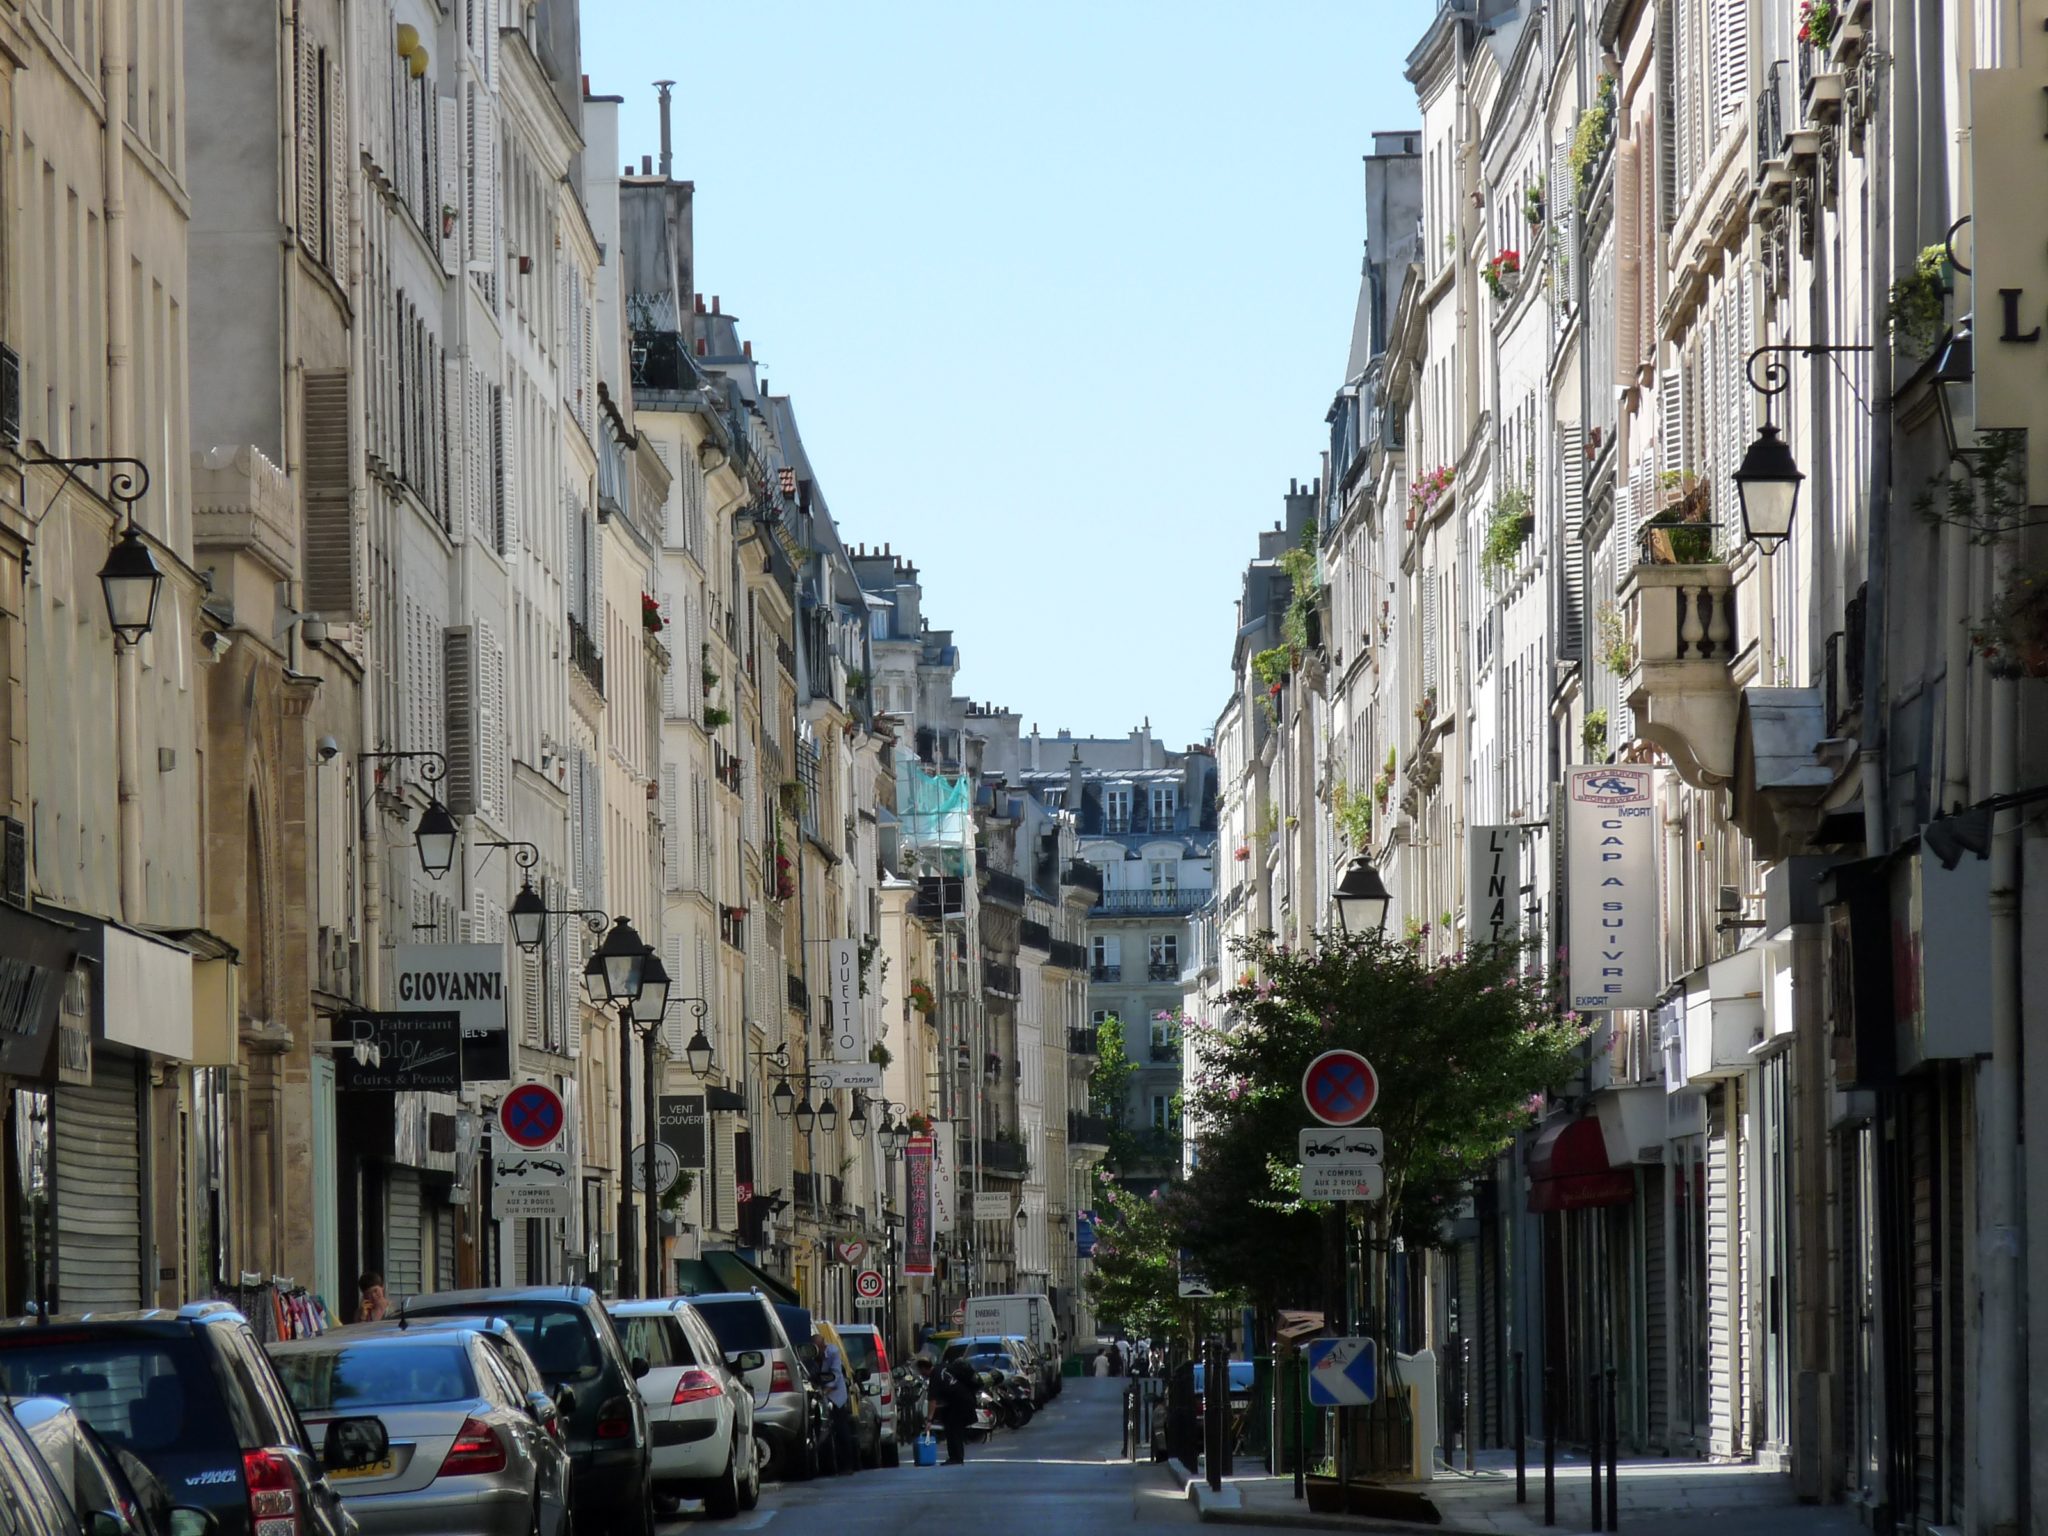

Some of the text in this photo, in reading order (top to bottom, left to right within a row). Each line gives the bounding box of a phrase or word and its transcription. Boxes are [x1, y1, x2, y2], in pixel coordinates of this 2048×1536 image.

[1618, 807, 1651, 817] IMPORT
[1601, 819, 1624, 993] CAP A SUIVRE
[400, 972, 502, 1001] GIOVANNI
[839, 951, 855, 1049] DUETTO
[1575, 996, 1609, 1006] EXPORT
[379, 1018, 453, 1031] Fabricant
[350, 1018, 415, 1060] Pblo
[353, 1073, 455, 1086] Cuirs & Peaux
[669, 1105, 694, 1114] VENT
[659, 1115, 705, 1125] COUVERT
[1327, 1169, 1363, 1177] COMPRIS
[862, 1278, 878, 1289] 30
